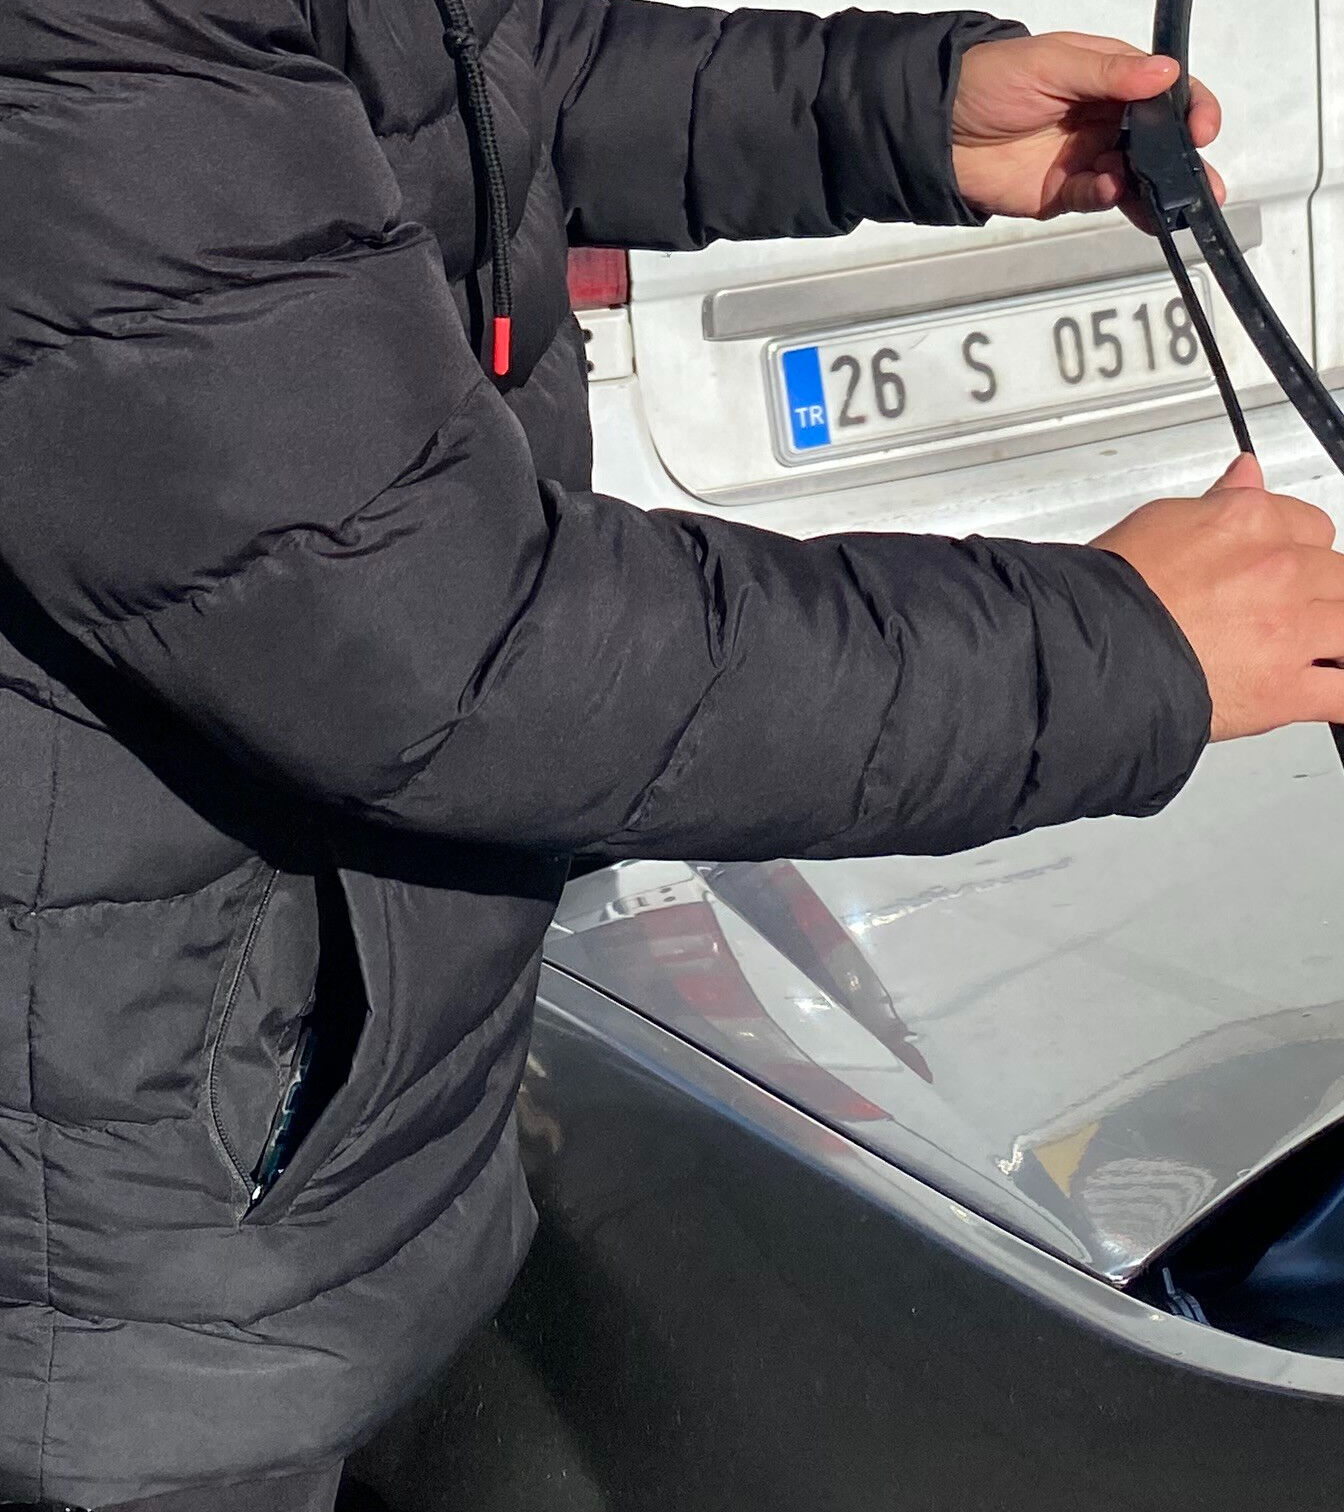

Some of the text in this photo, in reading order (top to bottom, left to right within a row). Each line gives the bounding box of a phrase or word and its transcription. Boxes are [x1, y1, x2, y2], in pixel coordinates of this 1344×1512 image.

[831, 297, 1199, 427] 26 S 0518
[795, 406, 825, 428] TR
